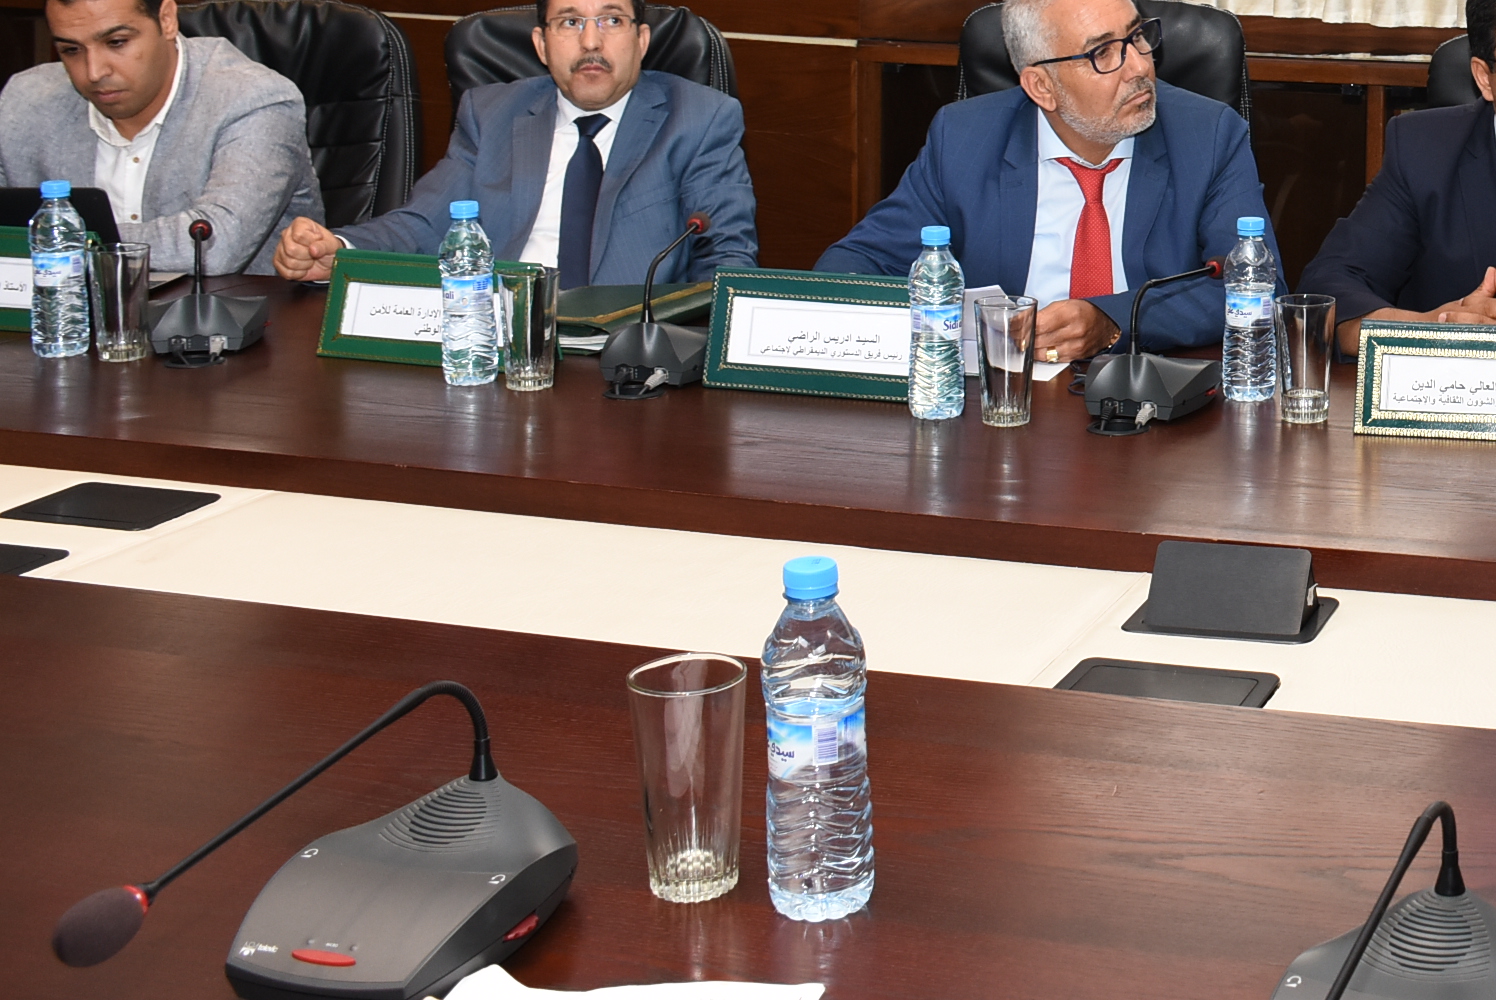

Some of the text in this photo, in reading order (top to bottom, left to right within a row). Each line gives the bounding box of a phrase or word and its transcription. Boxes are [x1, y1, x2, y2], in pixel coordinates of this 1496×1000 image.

[393, 304, 415, 316] العامة
[414, 323, 442, 336] الوطني
[943, 319, 959, 331] Sidi
[787, 330, 820, 343] الراضي
[856, 333, 881, 346] السيد
[830, 348, 862, 358] الدستوري
[864, 350, 881, 360] فريق
[883, 351, 902, 361] رئيس
[1411, 379, 1436, 391] الدين
[1439, 380, 1466, 394] حامي
[1438, 393, 1464, 405] الثقافية
